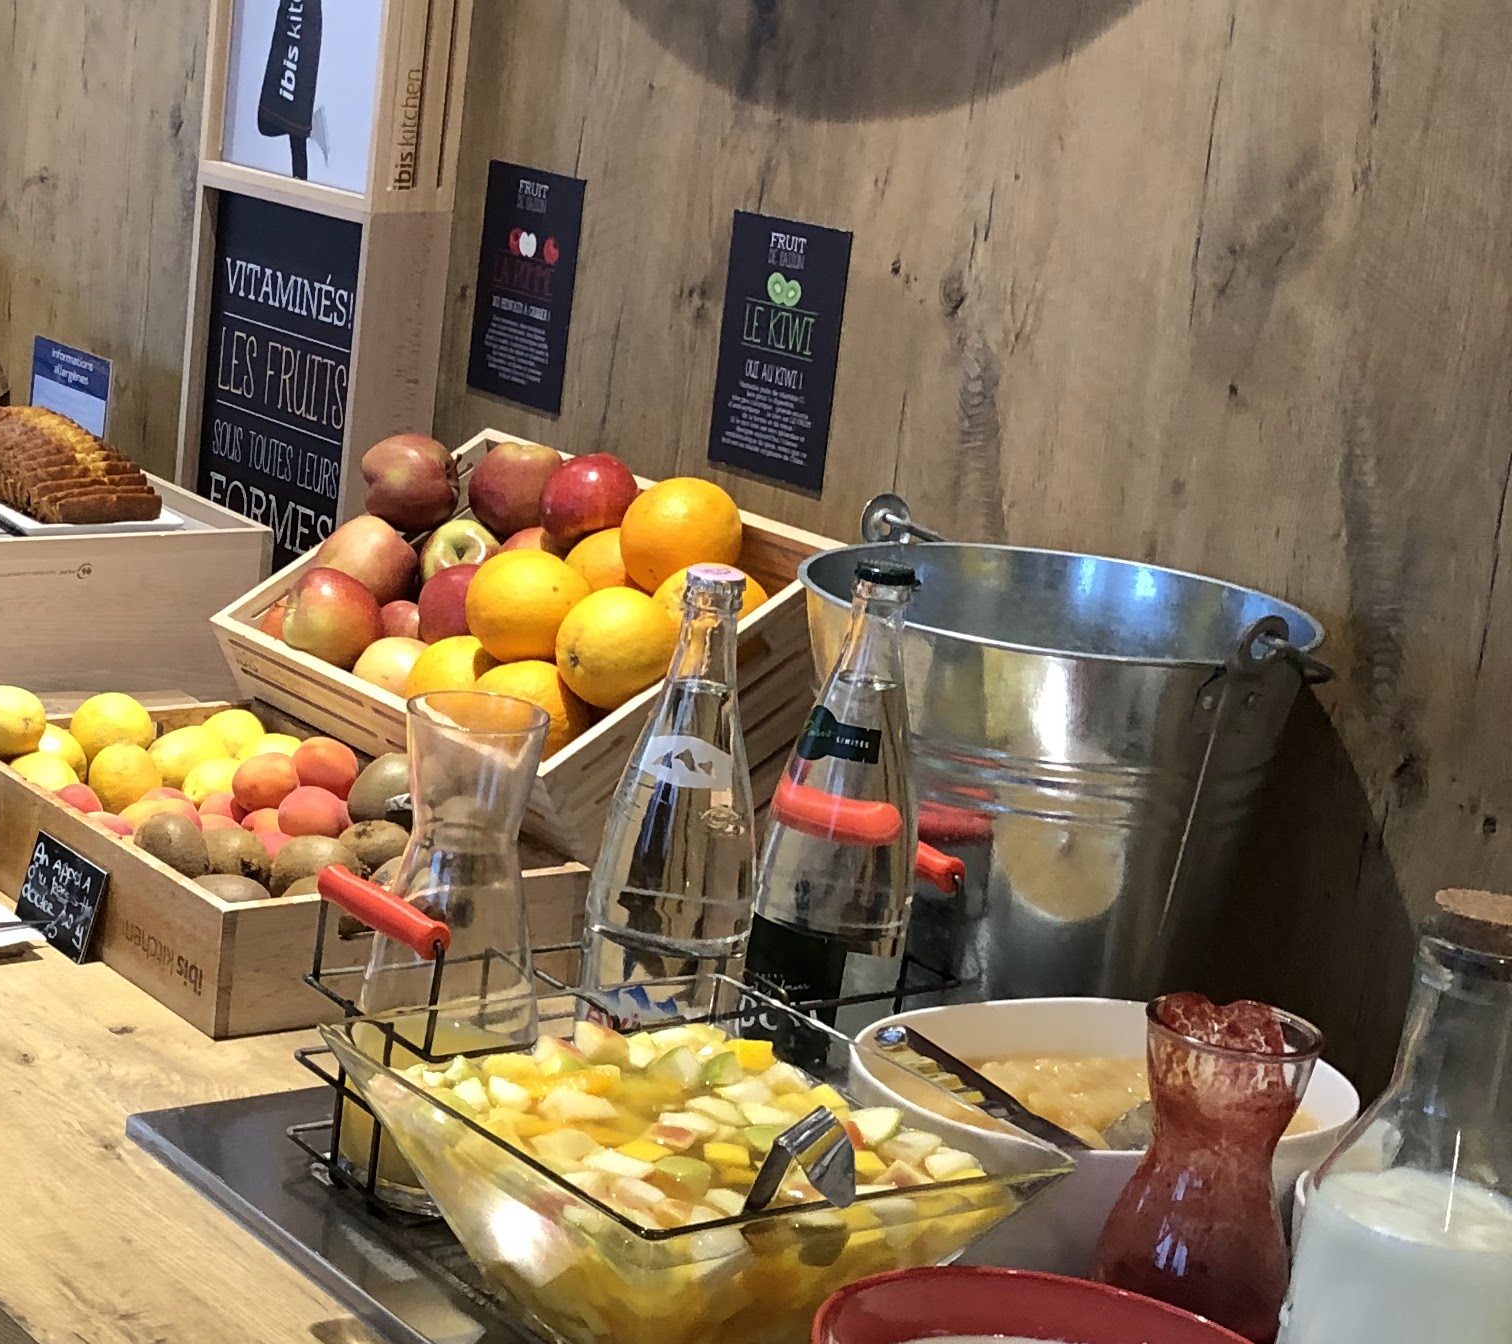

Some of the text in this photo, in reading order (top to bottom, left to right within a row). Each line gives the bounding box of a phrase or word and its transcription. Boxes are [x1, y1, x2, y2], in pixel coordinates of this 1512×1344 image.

[279, 45, 300, 102] ibis
[392, 67, 422, 192] ibis kitchen
[518, 179, 550, 199] FRUIT
[769, 231, 807, 254] FRUIT
[225, 256, 355, 330] VITAMINÉS!
[743, 302, 816, 356] LE KIWI
[217, 326, 347, 430] LES FRUITS
[212, 418, 339, 500] SOUS TOUTES LEURS
[176, 955, 204, 997] ibis
